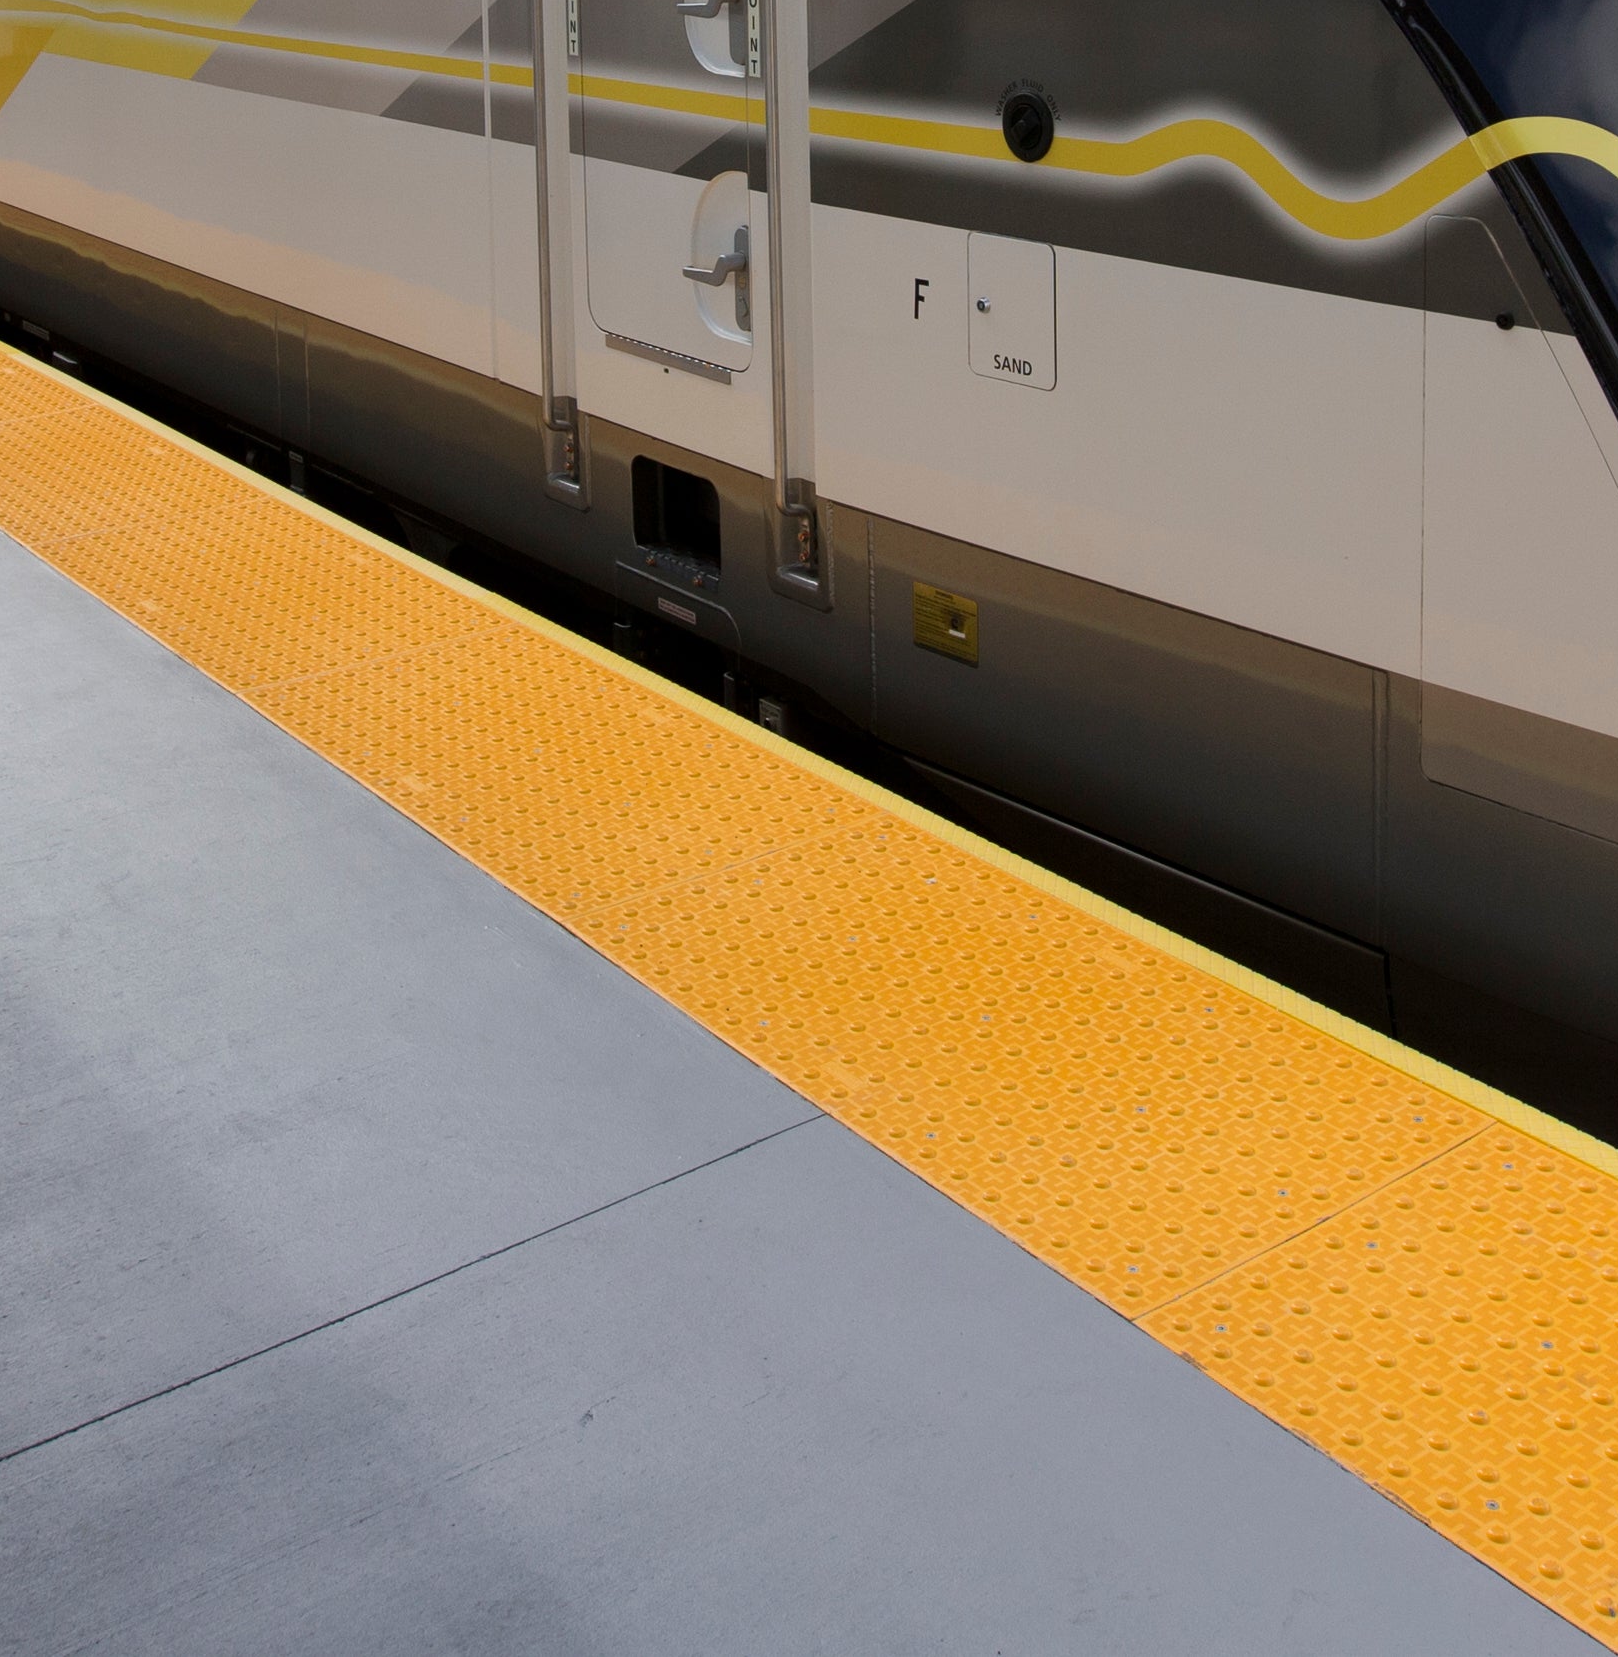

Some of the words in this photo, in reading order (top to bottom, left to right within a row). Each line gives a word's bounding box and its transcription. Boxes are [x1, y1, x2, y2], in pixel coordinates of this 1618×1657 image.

[1046, 94, 1062, 122] ONLY
[914, 278, 929, 320] F
[993, 354, 1032, 376] SAND
